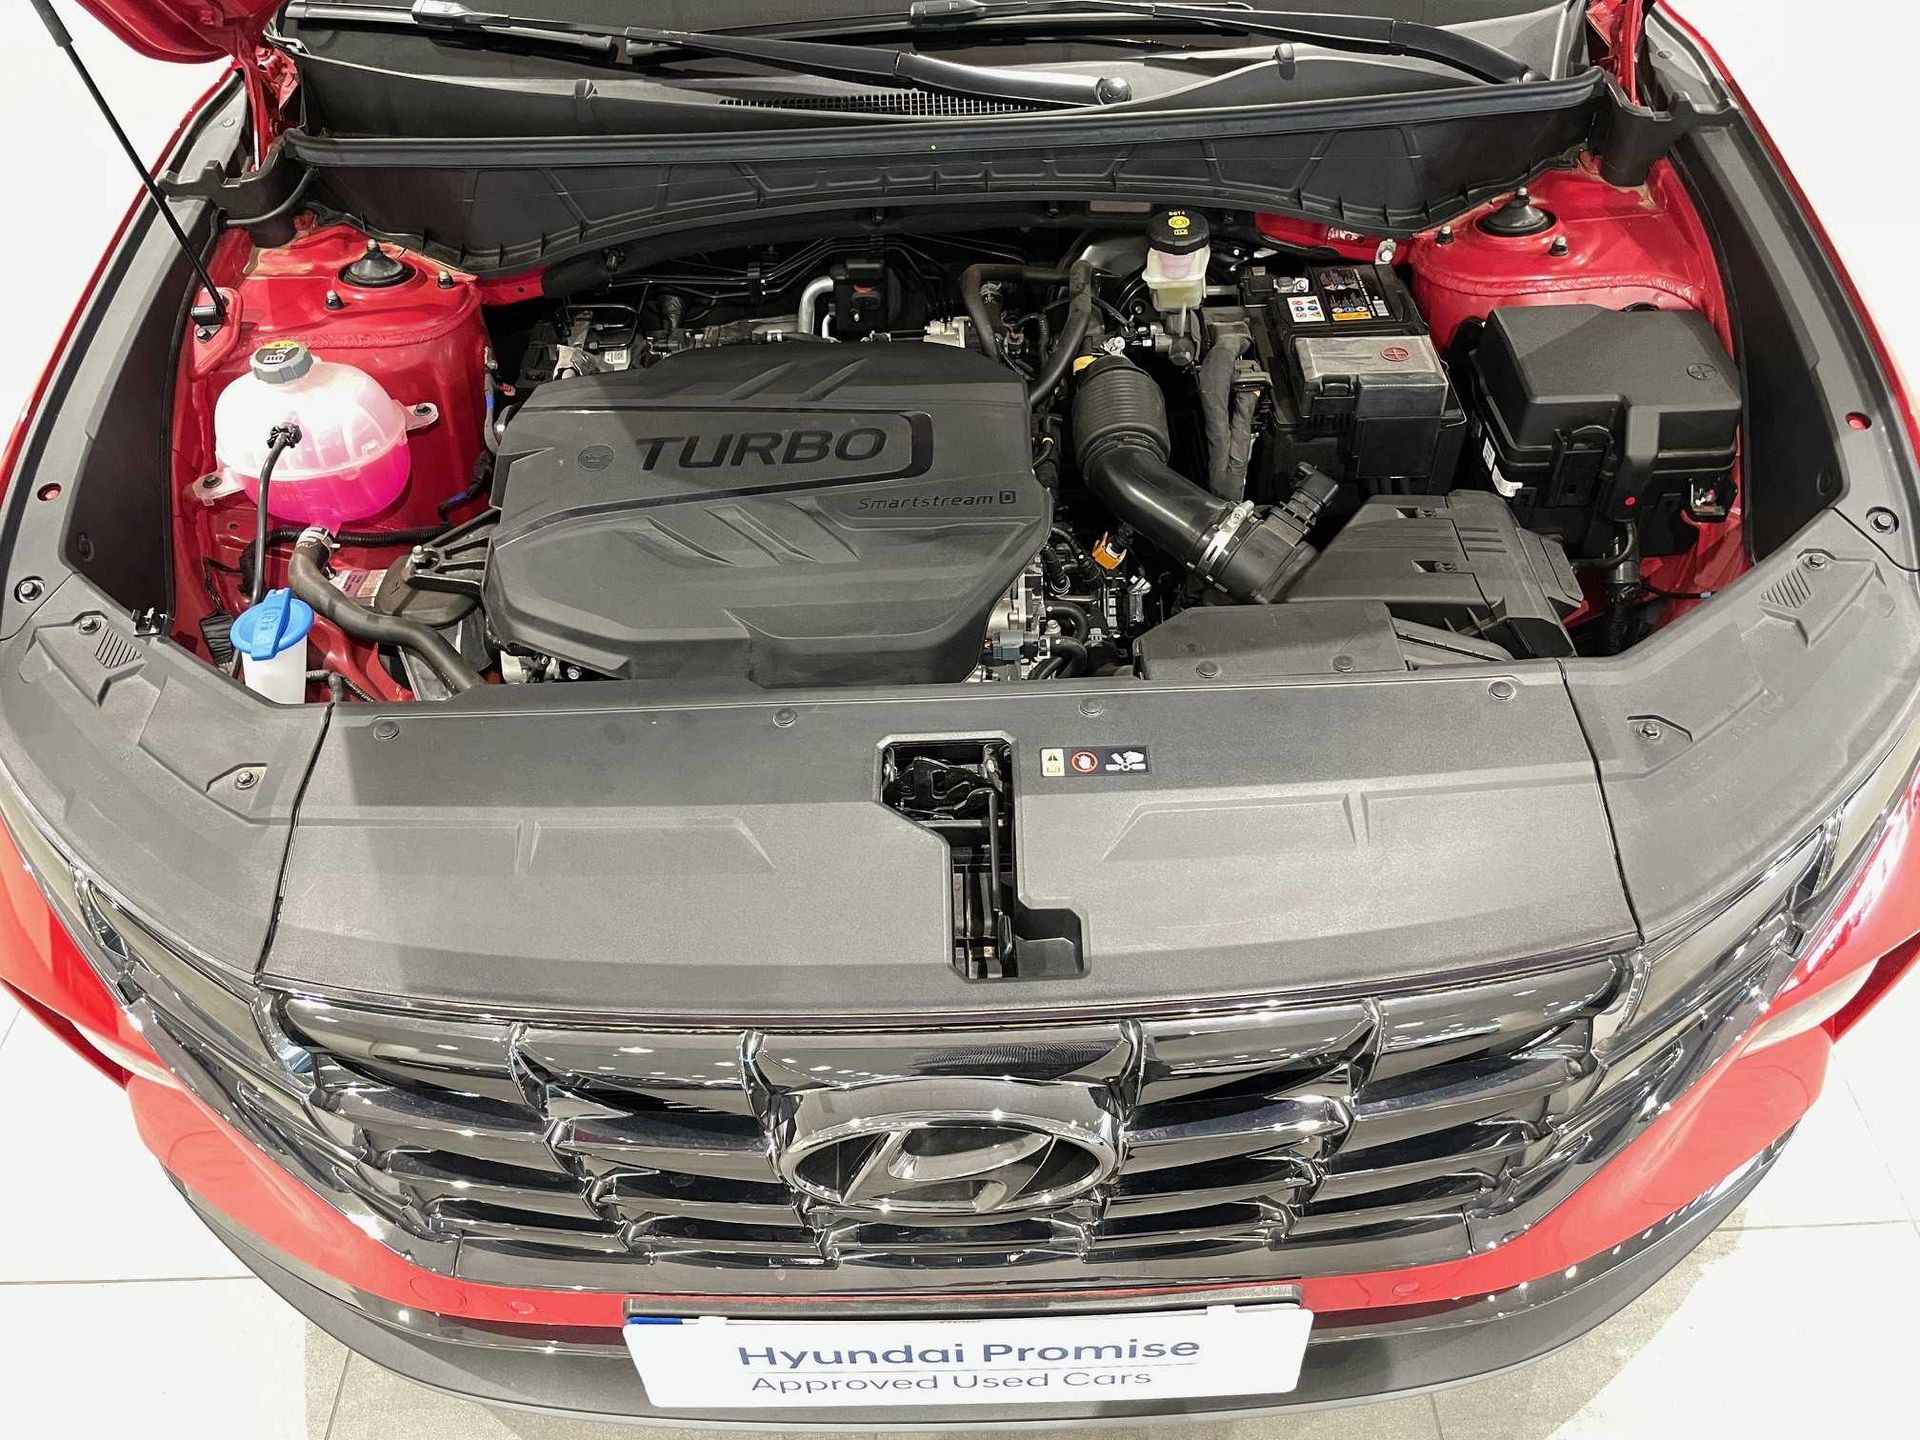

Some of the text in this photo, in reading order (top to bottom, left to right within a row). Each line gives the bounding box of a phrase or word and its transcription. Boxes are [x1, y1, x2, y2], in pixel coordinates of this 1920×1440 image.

[635, 427, 888, 471] TURBO
[857, 495, 994, 510] Smartstream
[738, 1338, 1200, 1369] Hyundai Promise
[751, 1371, 1152, 1394] Approved Used Cars
